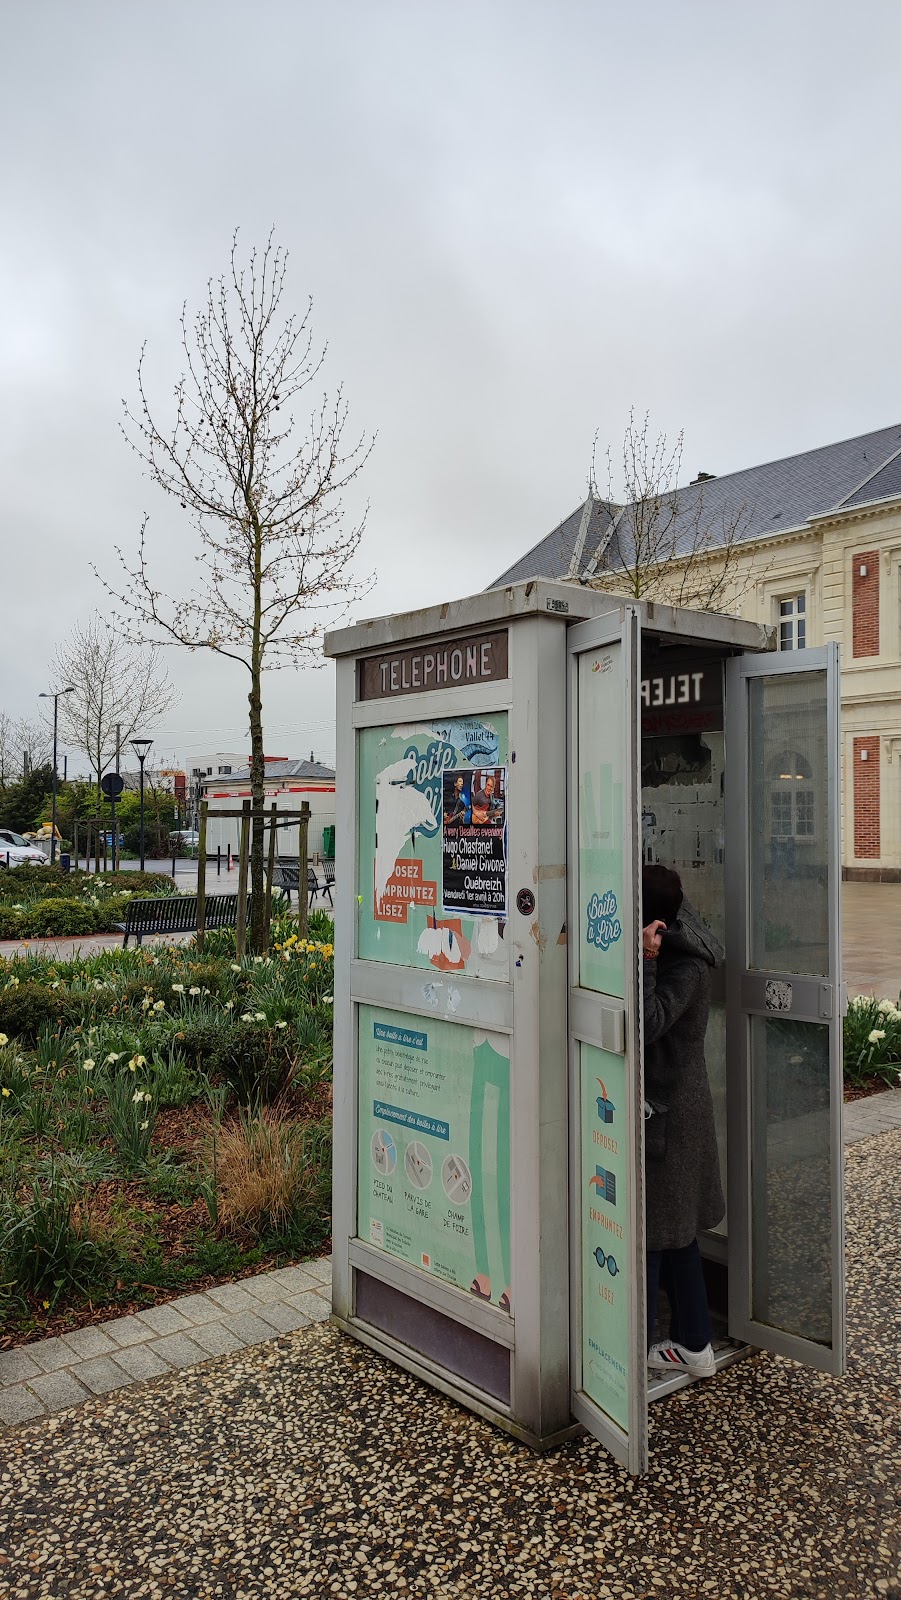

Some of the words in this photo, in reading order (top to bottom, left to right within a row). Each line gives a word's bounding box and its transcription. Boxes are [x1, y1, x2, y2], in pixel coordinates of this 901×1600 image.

[379, 642, 492, 692] TELEPHONE
[465, 731, 484, 742] Vallet
[443, 825, 447, 837] A
[447, 828, 459, 839] very
[459, 826, 480, 837] Beatles
[481, 826, 504, 840] evening
[443, 838, 458, 858] Hugo
[459, 837, 494, 855] Chastanet
[456, 854, 478, 871] Daniel
[479, 855, 505, 872] Givone
[380, 885, 434, 900] MPRUNTEZ
[464, 876, 502, 891] Québreizh
[443, 889, 466, 900] Vendredi
[466, 889, 474, 901] 1er
[474, 890, 487, 902] avril
[488, 890, 492, 902] à
[492, 892, 505, 903] 20h
[588, 921, 595, 940] à
[595, 919, 621, 948] Lire
[373, 1179, 386, 1190] PIED
[386, 1184, 393, 1193] DU
[404, 1191, 423, 1206] PARVIS
[424, 1199, 432, 1209] DE
[407, 1204, 415, 1214] LA
[415, 1207, 429, 1219] GARE
[447, 1209, 465, 1223] CHAMP
[443, 1218, 451, 1228] DE
[452, 1222, 470, 1237] FOIRE
[589, 1206, 623, 1240] EMPRUNTEZ
[598, 1282, 615, 1307] LISEZ
[588, 1337, 627, 1378] EMPLACEMENT
